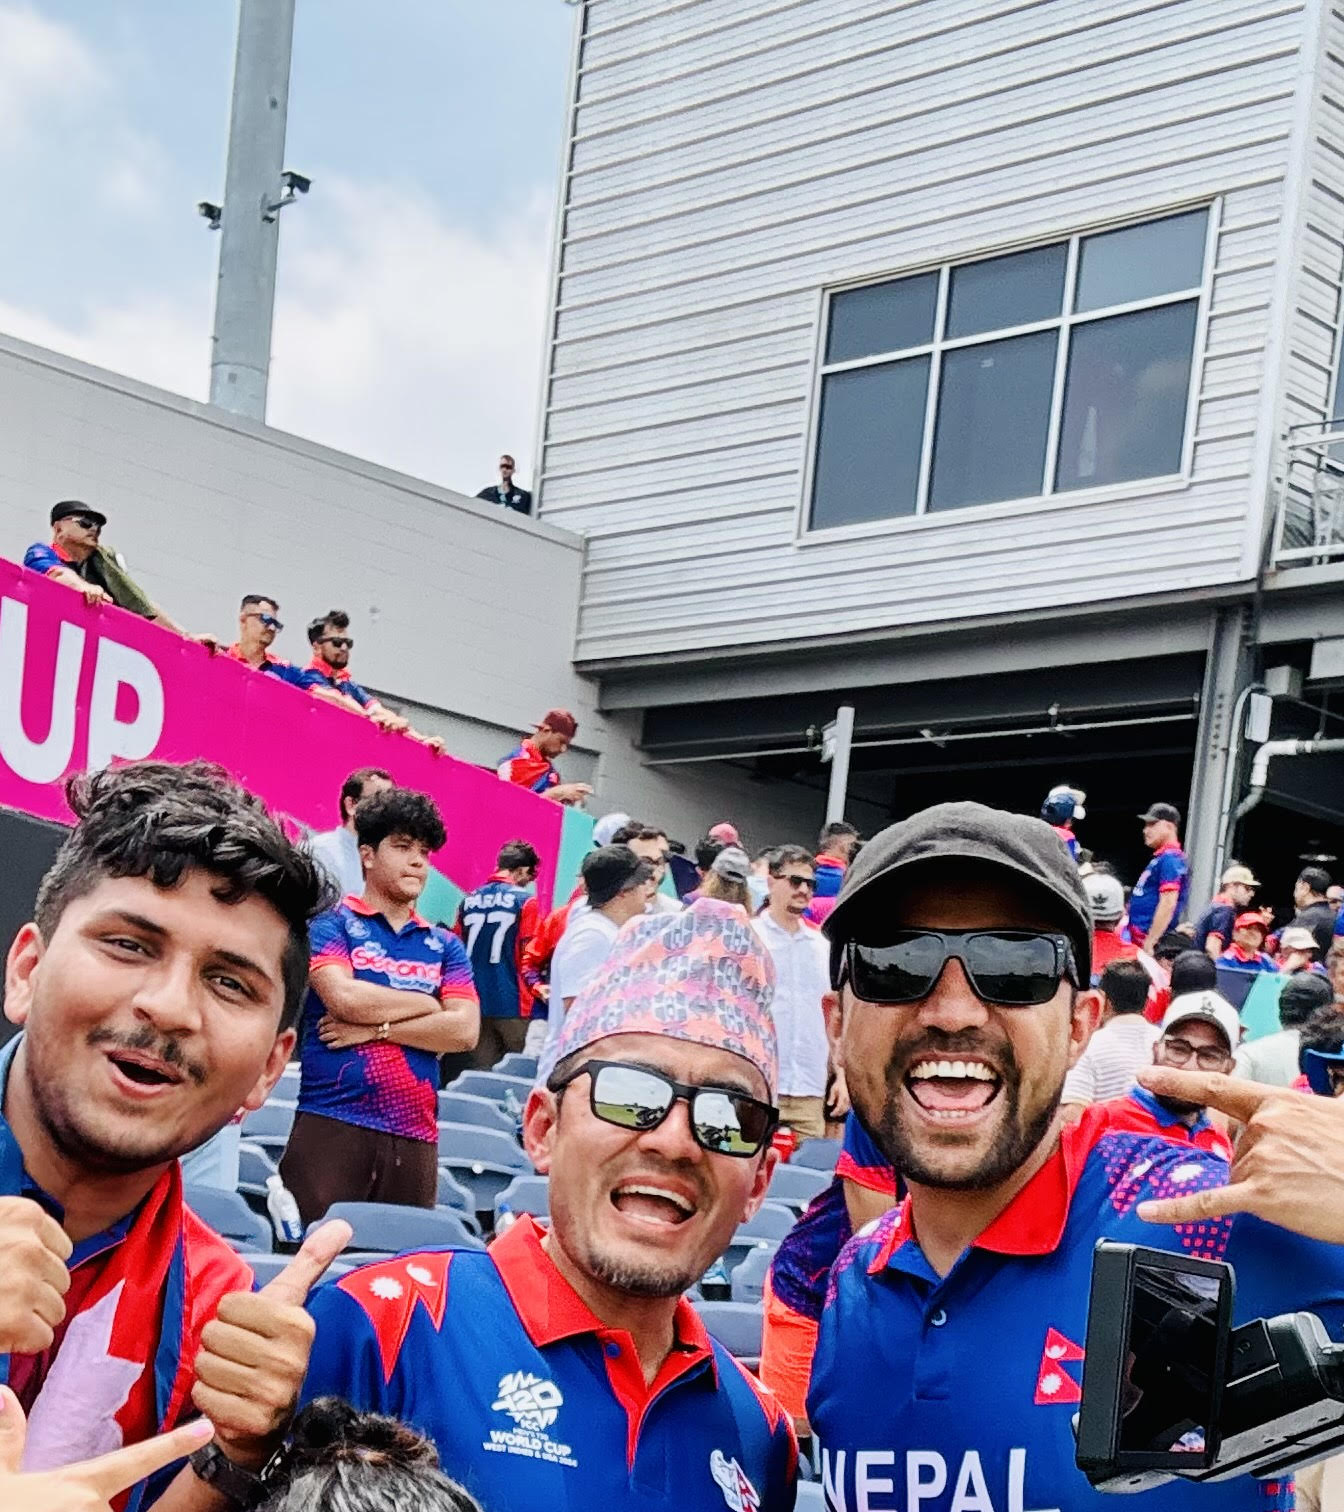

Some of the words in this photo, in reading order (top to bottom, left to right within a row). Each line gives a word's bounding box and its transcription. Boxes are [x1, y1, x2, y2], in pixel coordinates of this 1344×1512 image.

[463, 910, 516, 964] 77
[489, 1430, 542, 1451] WORLD
[543, 1441, 572, 1457] CUP
